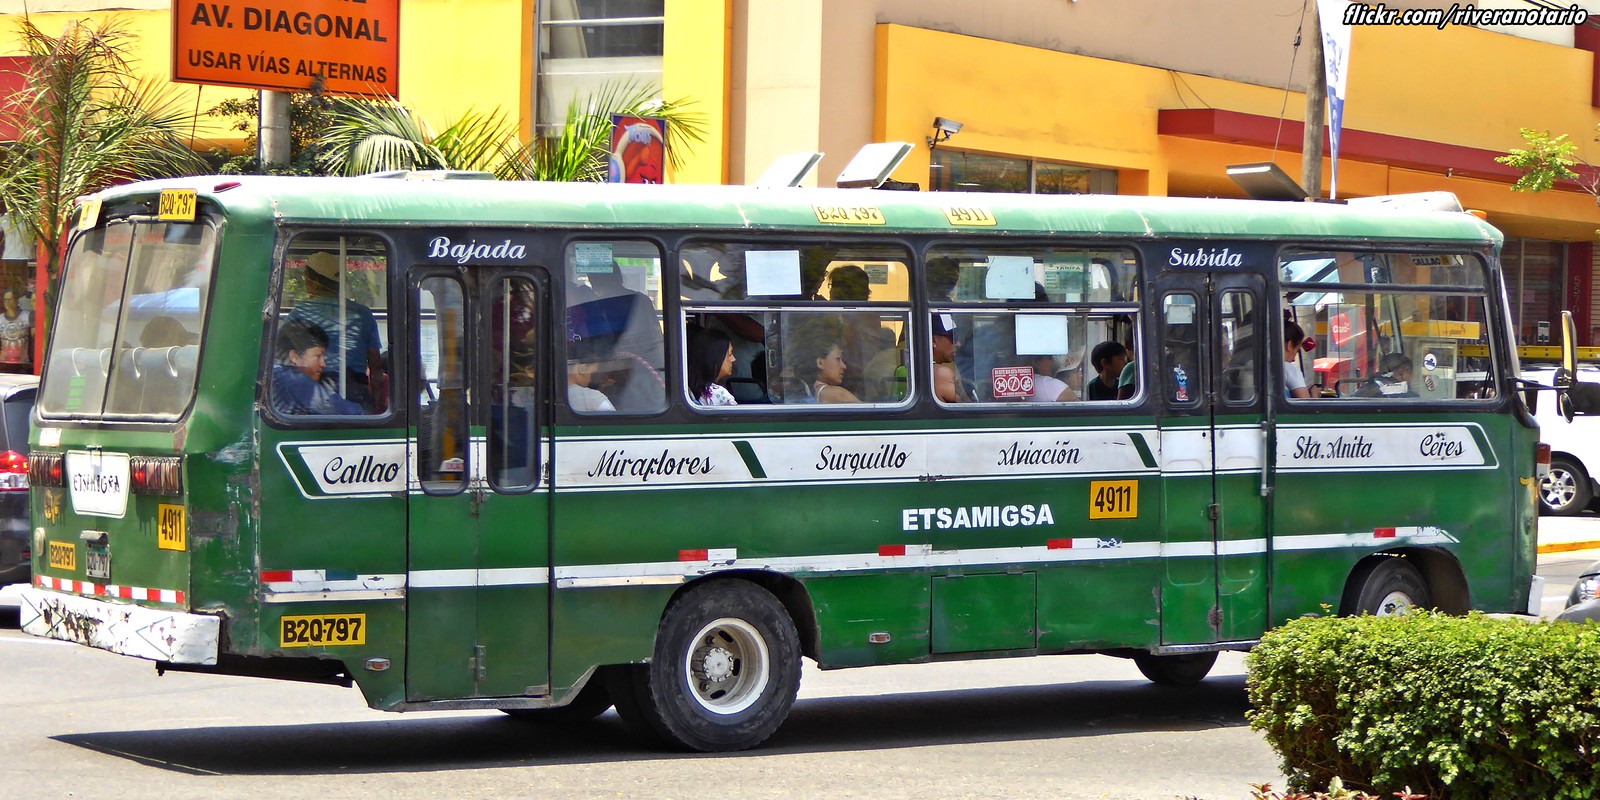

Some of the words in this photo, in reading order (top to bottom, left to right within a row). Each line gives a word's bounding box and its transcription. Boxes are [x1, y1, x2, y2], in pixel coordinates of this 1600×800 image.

[191, 3, 233, 28] AV.
[244, 7, 388, 42] DIAGONAL
[188, 49, 241, 70] USAR
[247, 51, 290, 75] VÍAS
[295, 60, 387, 84] ALTERNAS
[951, 207, 988, 221] 4911
[428, 236, 527, 264] Bajada
[1169, 248, 1242, 267] Subida
[815, 443, 912, 475] Surquillo
[1420, 434, 1465, 457] Ceres
[323, 455, 402, 485] Callao
[587, 449, 716, 482] Miraflores
[1094, 485, 1131, 513] 4911
[161, 507, 182, 542] 4911
[902, 503, 1054, 531] ETSAMIGSA
